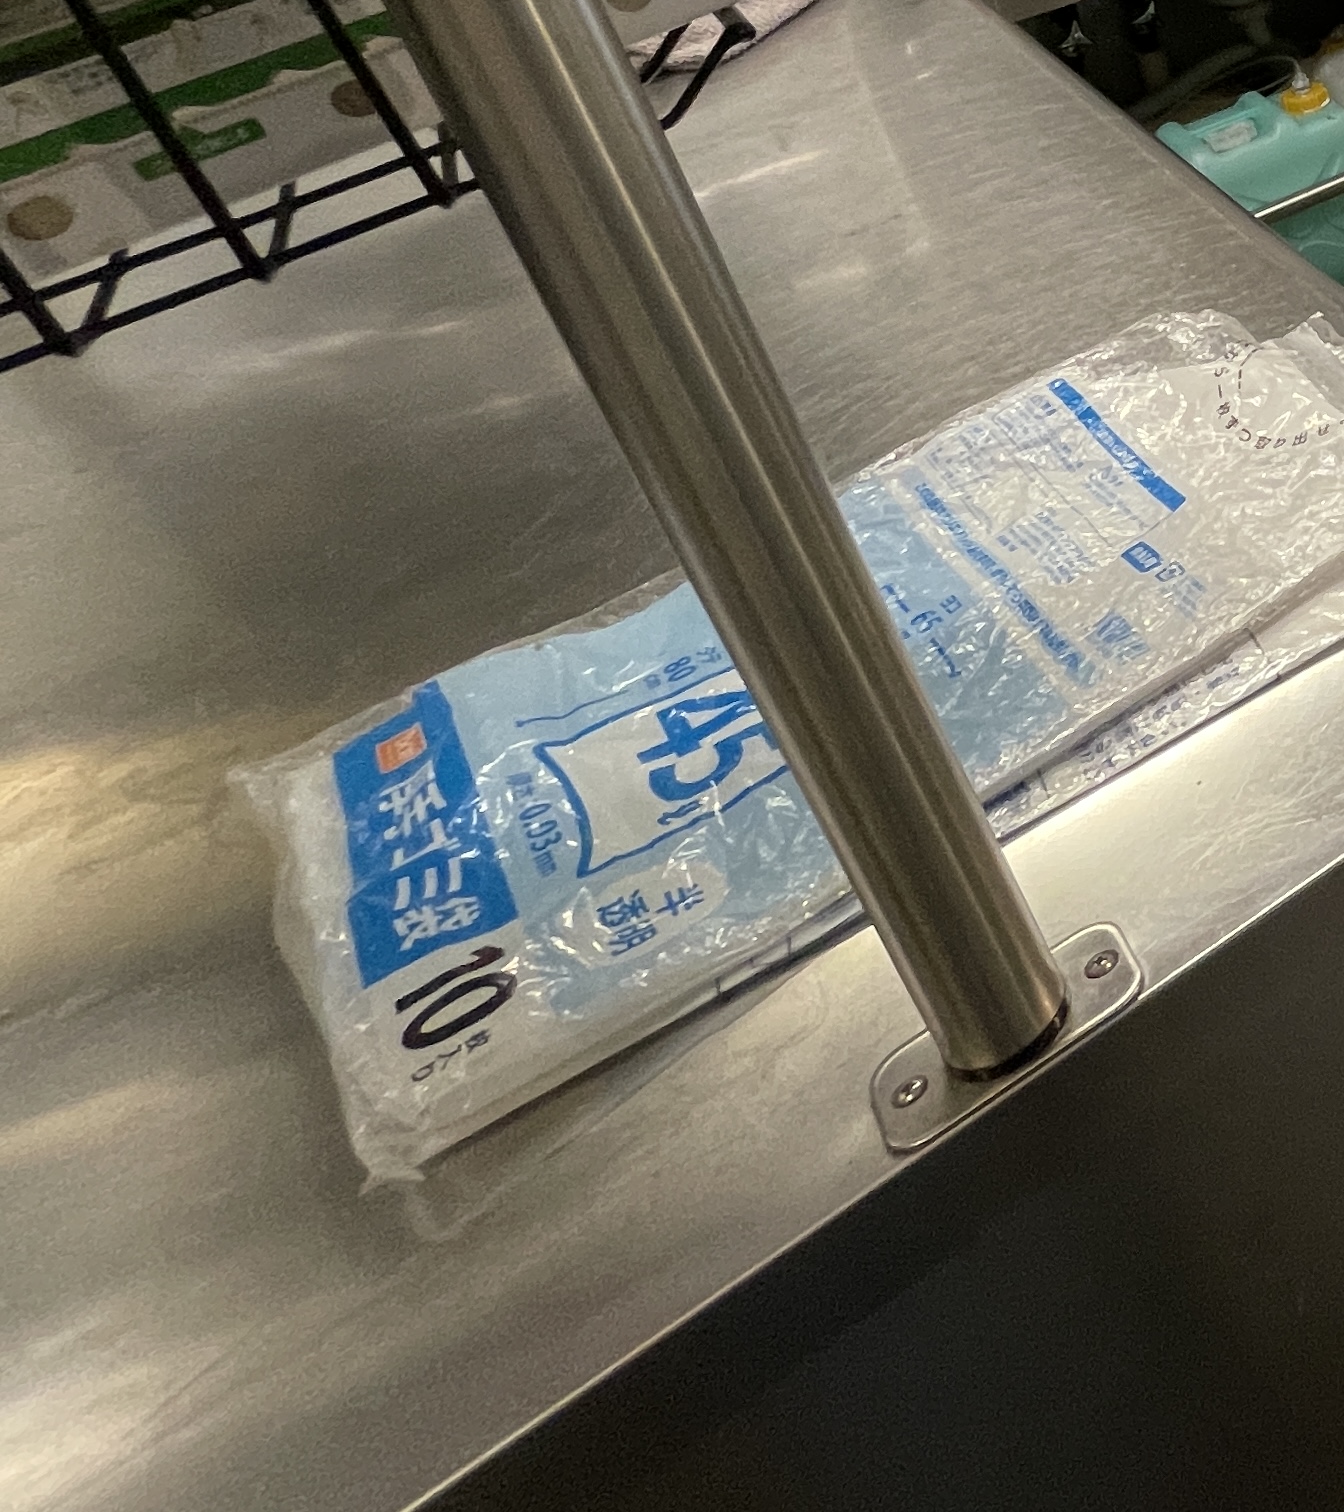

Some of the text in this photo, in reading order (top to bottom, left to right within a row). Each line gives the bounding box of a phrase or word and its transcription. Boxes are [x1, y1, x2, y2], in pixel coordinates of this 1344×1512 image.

[911, 607, 944, 634] 65
[663, 654, 698, 683] 80
[654, 883, 706, 917] 半
[596, 889, 658, 957] 透明
[394, 944, 519, 1053] 10
